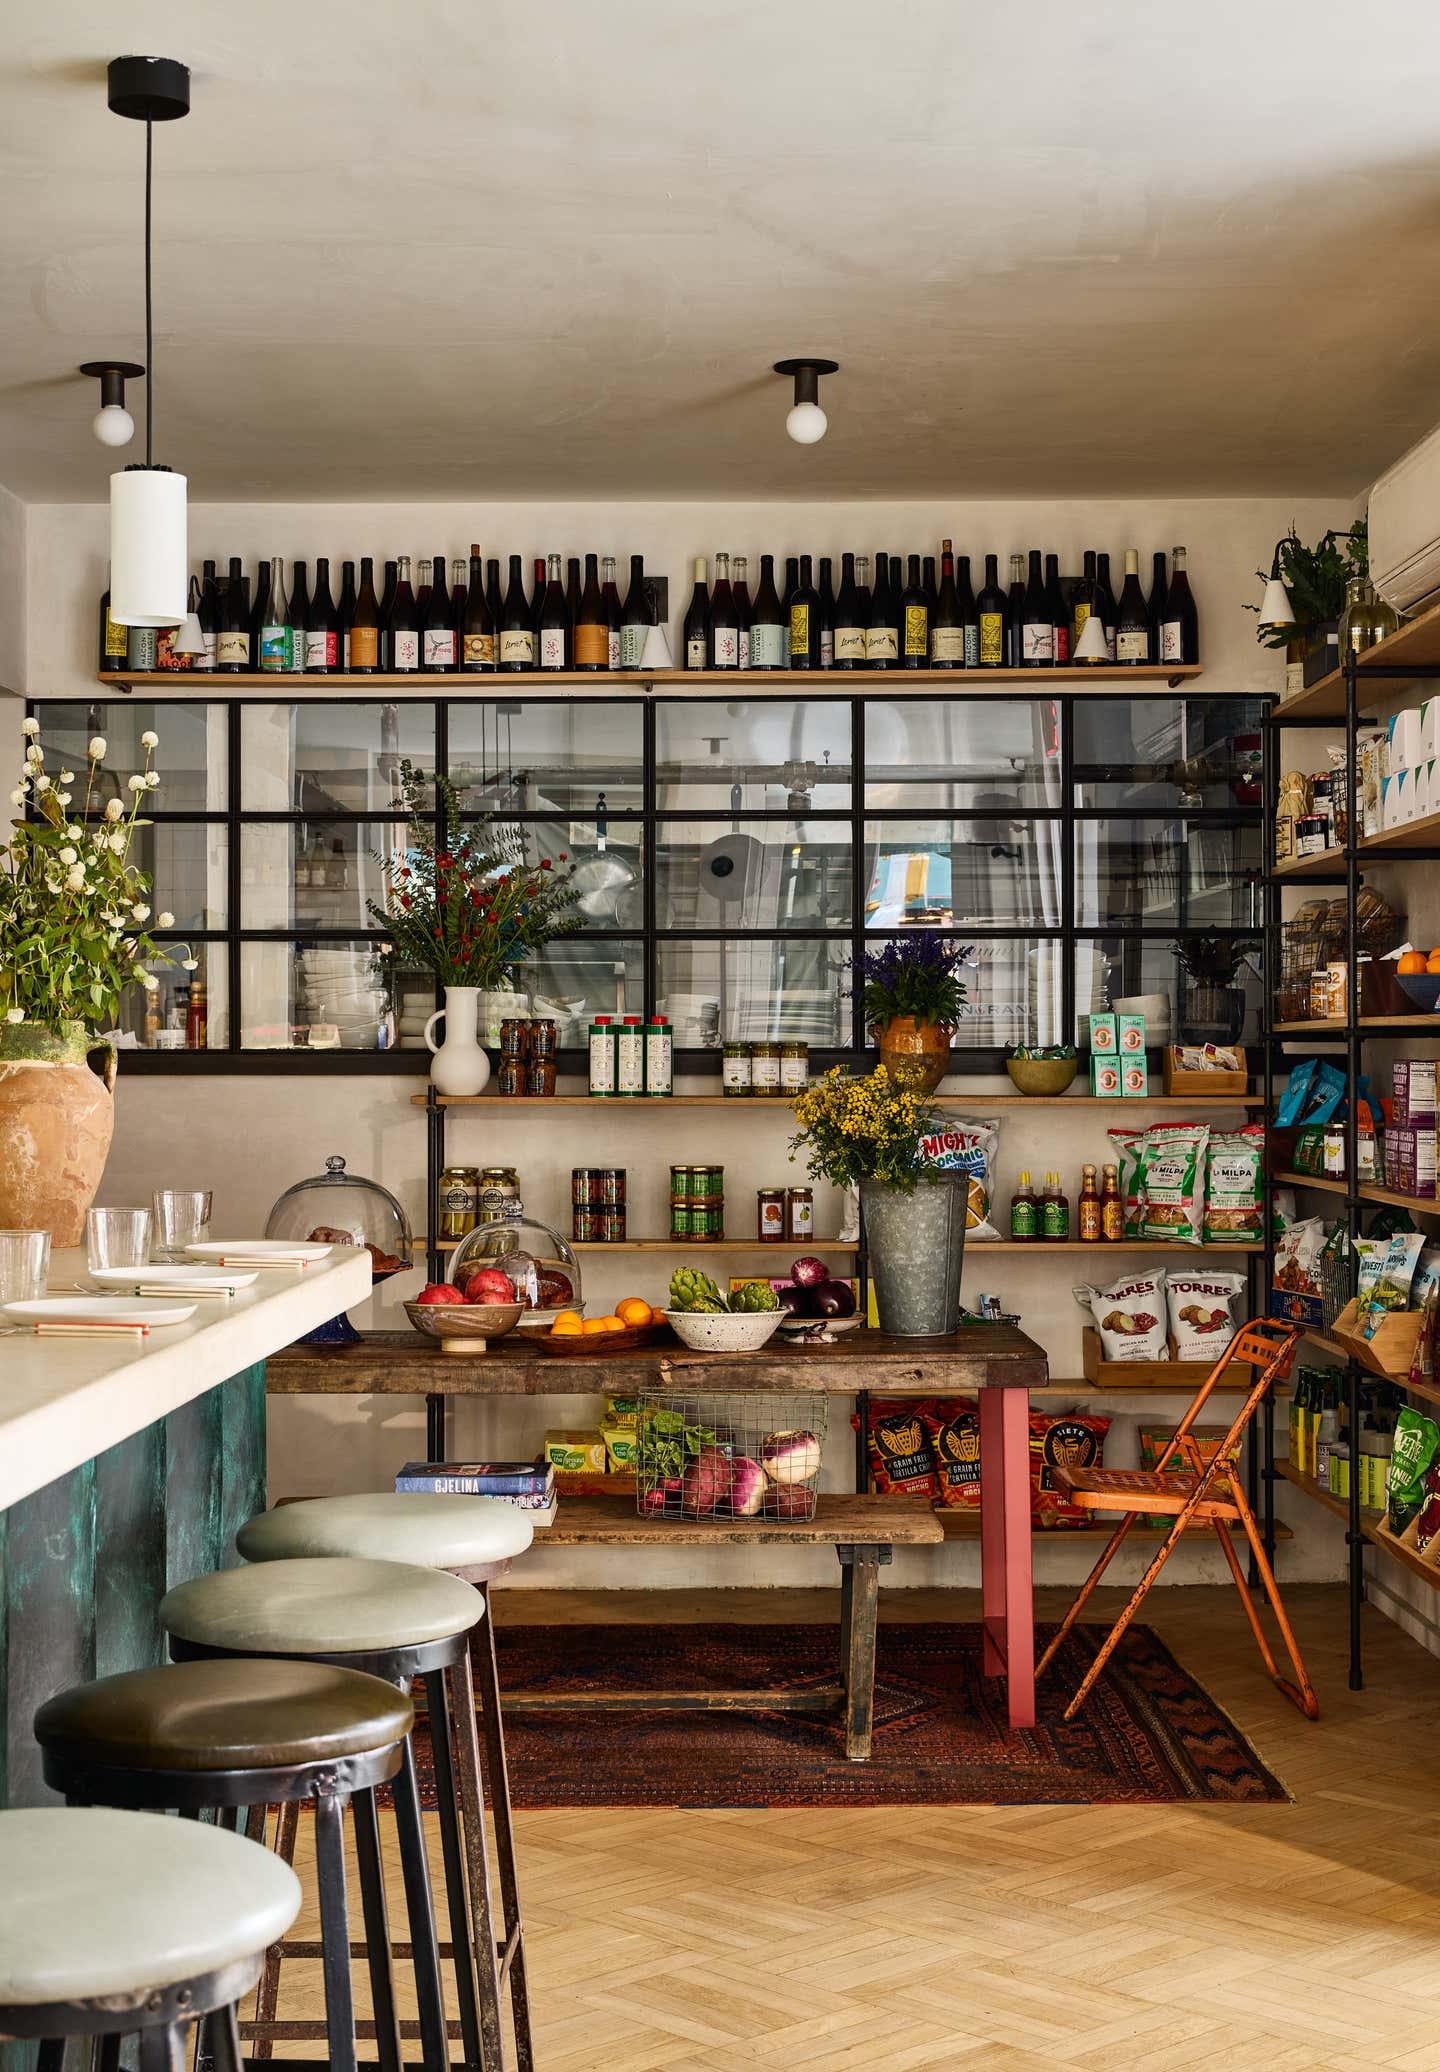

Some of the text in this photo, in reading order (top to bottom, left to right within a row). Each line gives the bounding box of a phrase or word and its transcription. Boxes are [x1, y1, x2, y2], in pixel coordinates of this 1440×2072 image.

[937, 1148, 984, 1168] ORGANIC
[1159, 1166, 1185, 1175] MILPA
[1222, 1169, 1252, 1177] MILPA
[1171, 1283, 1233, 1297] TORRES
[1057, 1428, 1085, 1437] SIETE
[893, 1453, 928, 1468] GRAIN FREE
[953, 1465, 973, 1473] GRAIN
[434, 1479, 480, 1493] GJELINA
[906, 1483, 929, 1492] NACHO
